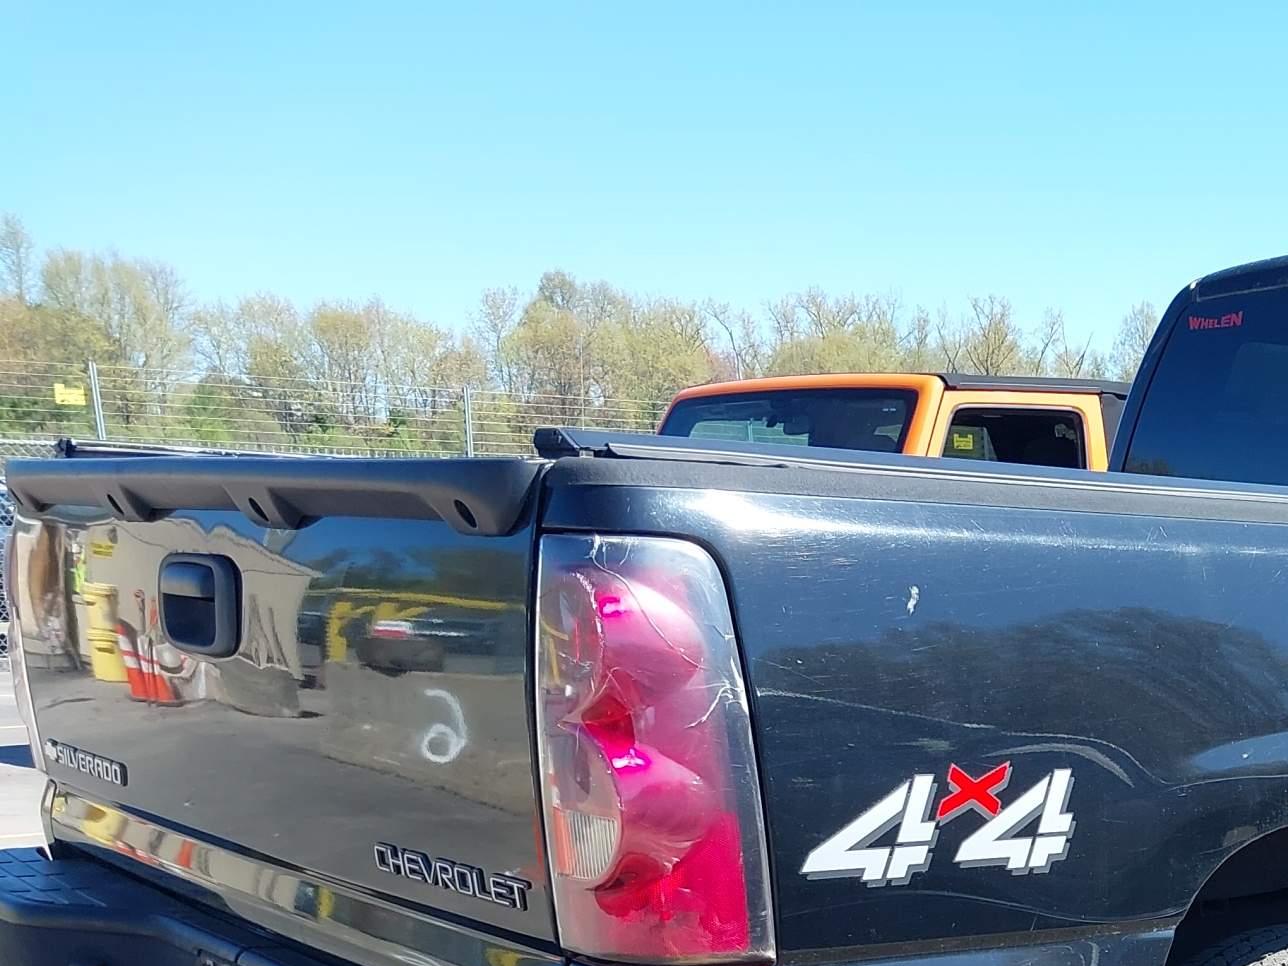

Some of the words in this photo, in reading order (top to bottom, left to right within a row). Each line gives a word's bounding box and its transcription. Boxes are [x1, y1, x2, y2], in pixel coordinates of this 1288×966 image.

[1189, 311, 1244, 330] WHELEN
[56, 746, 121, 785] SILVERADO
[374, 842, 532, 911] CHEVROLET
